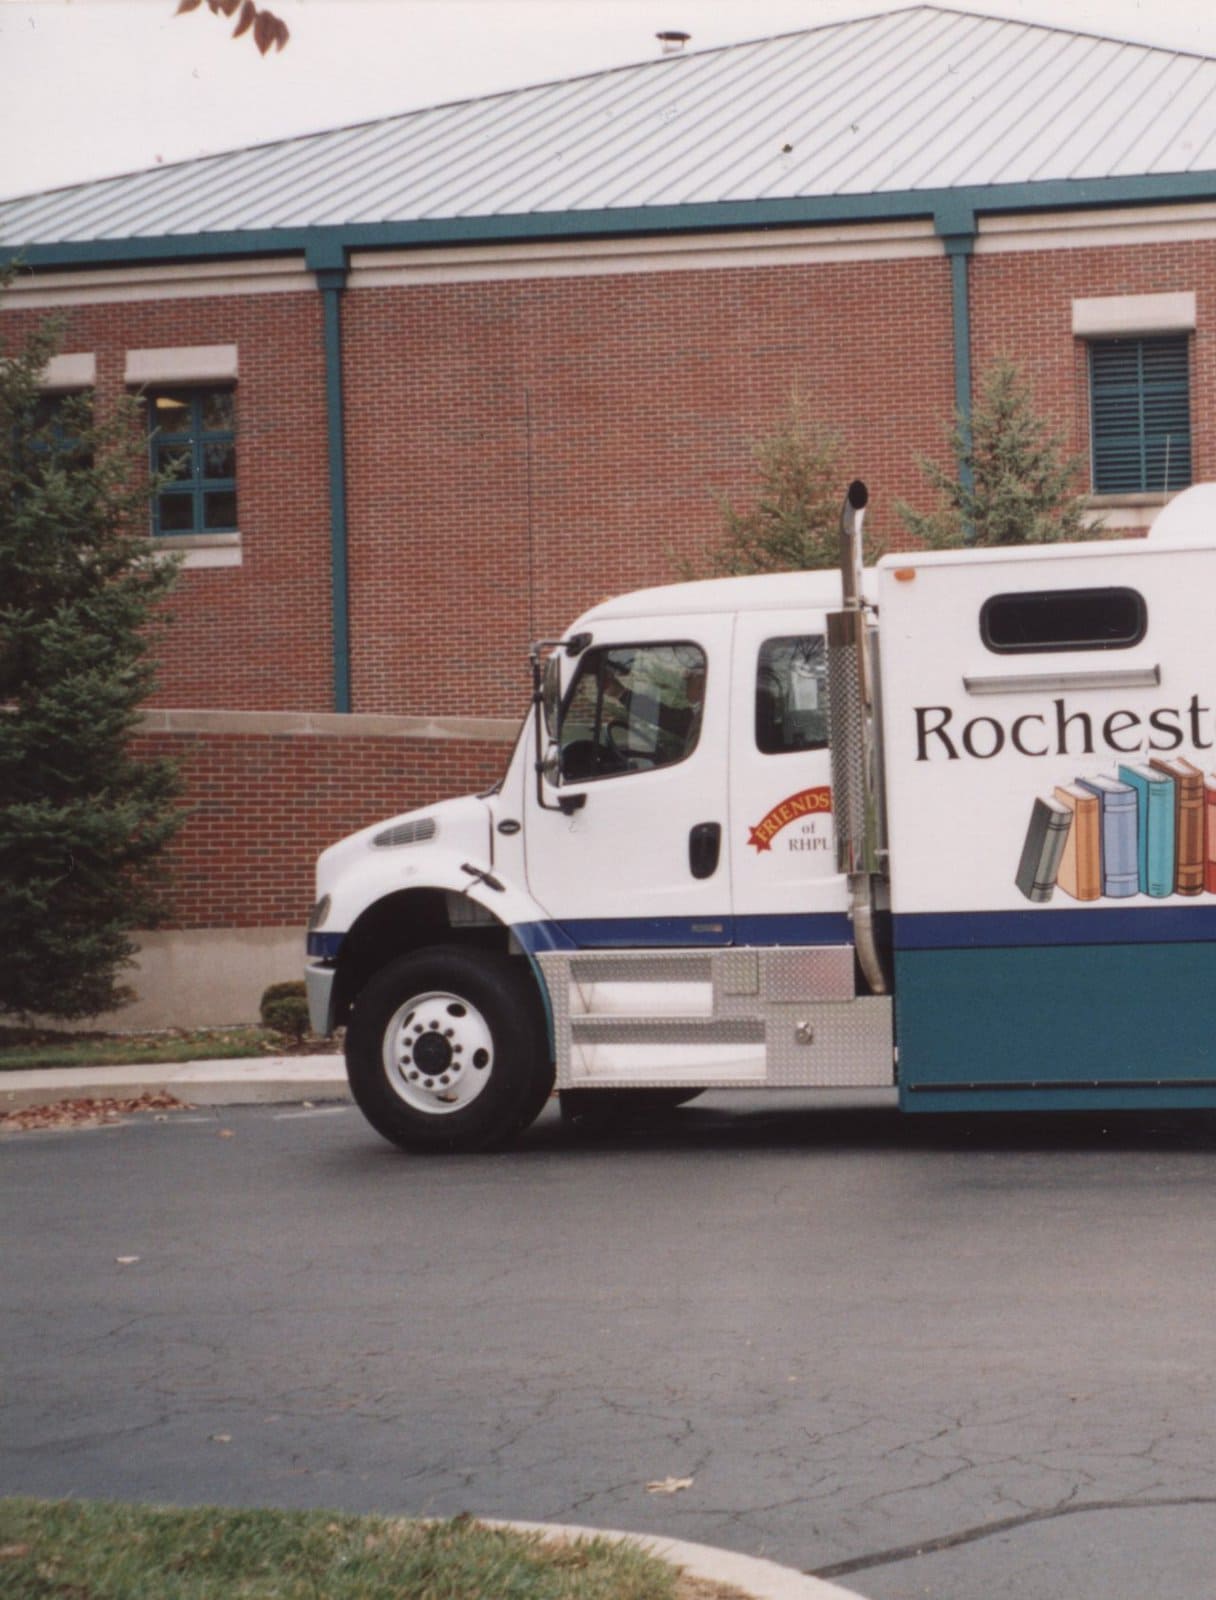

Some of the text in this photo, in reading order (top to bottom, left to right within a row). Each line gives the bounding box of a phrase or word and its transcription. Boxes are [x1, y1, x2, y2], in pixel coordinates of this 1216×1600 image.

[755, 793, 831, 842] FRIENDS
[801, 820, 816, 834] of
[788, 836, 832, 852] RHPL
